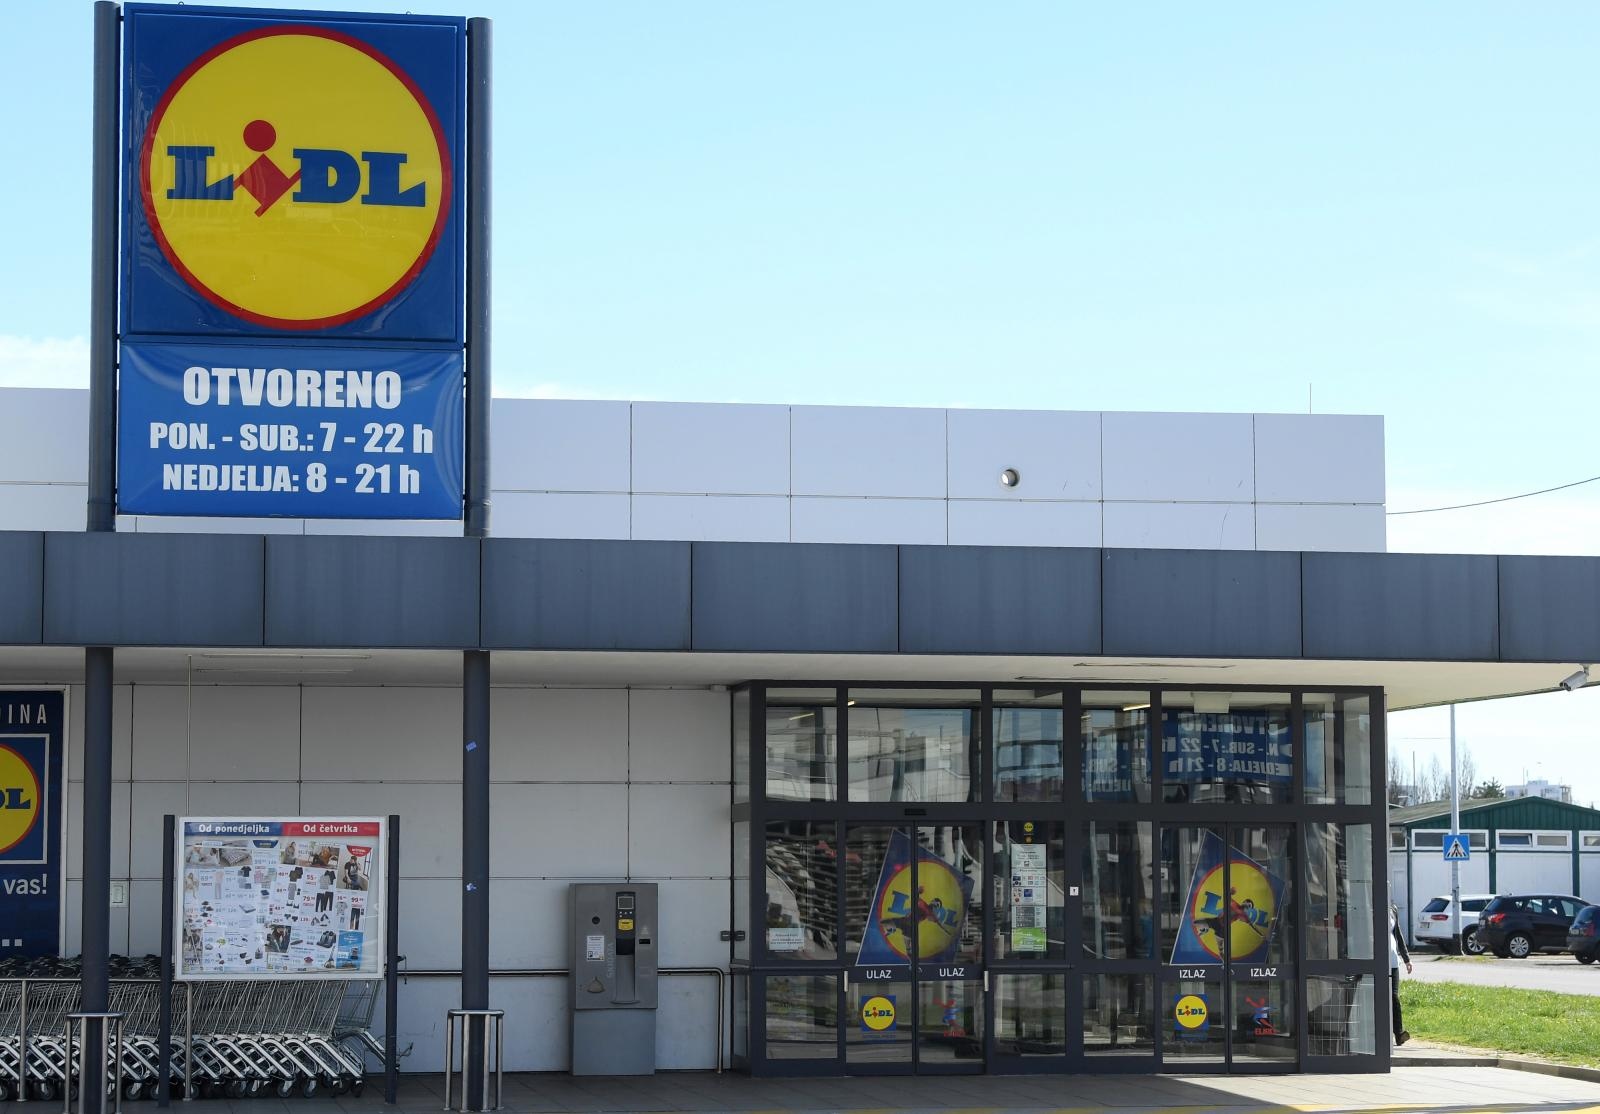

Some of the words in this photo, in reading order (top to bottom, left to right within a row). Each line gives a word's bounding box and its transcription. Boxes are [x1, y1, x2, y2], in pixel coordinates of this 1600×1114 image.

[183, 366, 402, 409] OTVORENO
[150, 422, 216, 449] PON.
[240, 424, 314, 451] SUB.:
[319, 422, 337, 452] 7
[363, 422, 404, 453] 22
[413, 424, 433, 453] h
[163, 463, 299, 492] NEDJELJA:
[306, 462, 327, 493] 8
[355, 463, 391, 493] 21
[399, 465, 421, 494] h
[0, 704, 48, 724] INA
[199, 824, 214, 833] Od
[215, 824, 270, 835] ponedjeljka
[303, 824, 316, 833] Od
[319, 824, 358, 833] četvrtka
[3, 873, 48, 895] vas!
[866, 969, 892, 979] ULAZ
[939, 967, 965, 977] ULAZ
[1179, 969, 1206, 979] IZLAZ
[1250, 967, 1277, 977] IZLAZ
